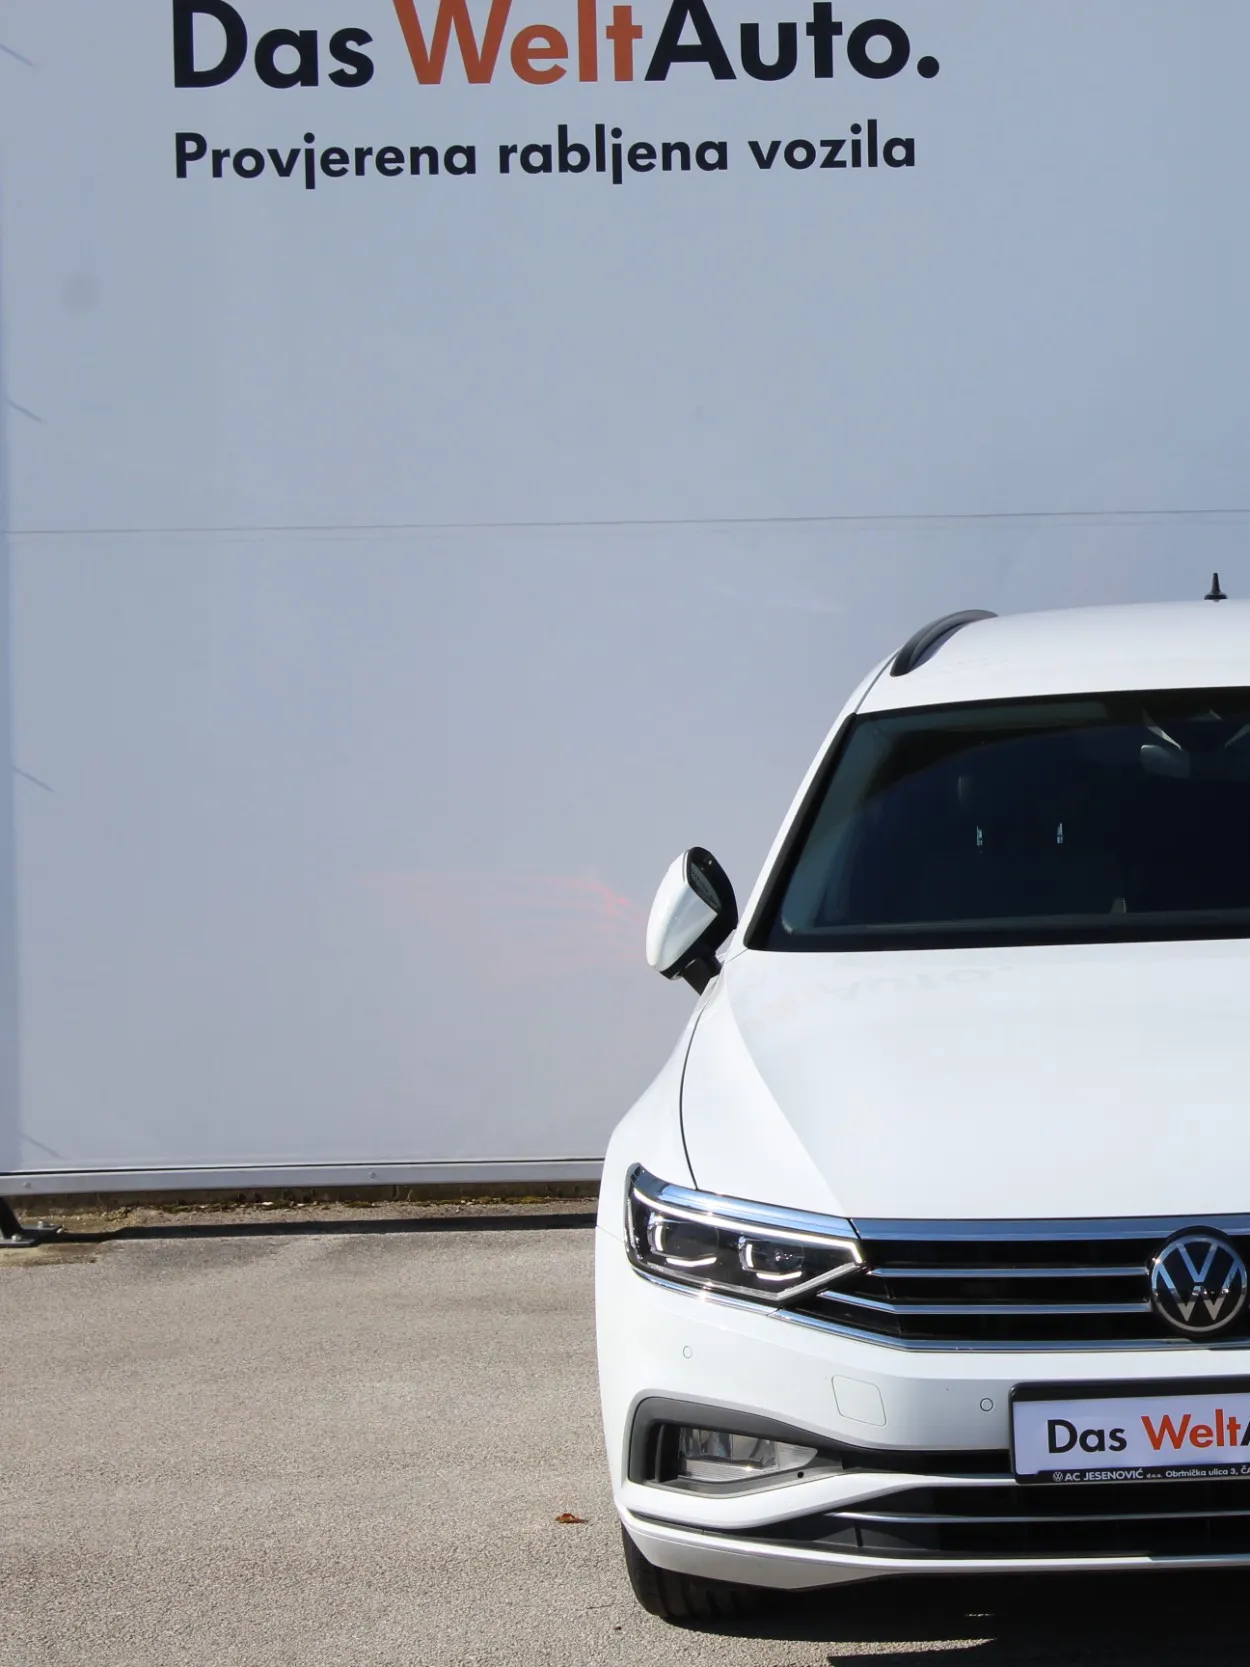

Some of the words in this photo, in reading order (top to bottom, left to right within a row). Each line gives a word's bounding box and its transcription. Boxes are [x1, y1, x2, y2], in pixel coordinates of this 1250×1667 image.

[172, 0, 375, 89] Das
[392, 0, 940, 86] WeltAuto.
[175, 131, 477, 190] Provjerena
[498, 123, 728, 185] rabljena
[747, 118, 915, 170] vozila
[1046, 1418, 1128, 1454] Das
[1064, 1472, 1081, 1482] AC
[1083, 1468, 1144, 1481] JESENOVIĆ
[1165, 1469, 1207, 1478] Obrtnička
[1208, 1468, 1229, 1476] ulica
[1230, 1468, 1239, 1476] 3,
